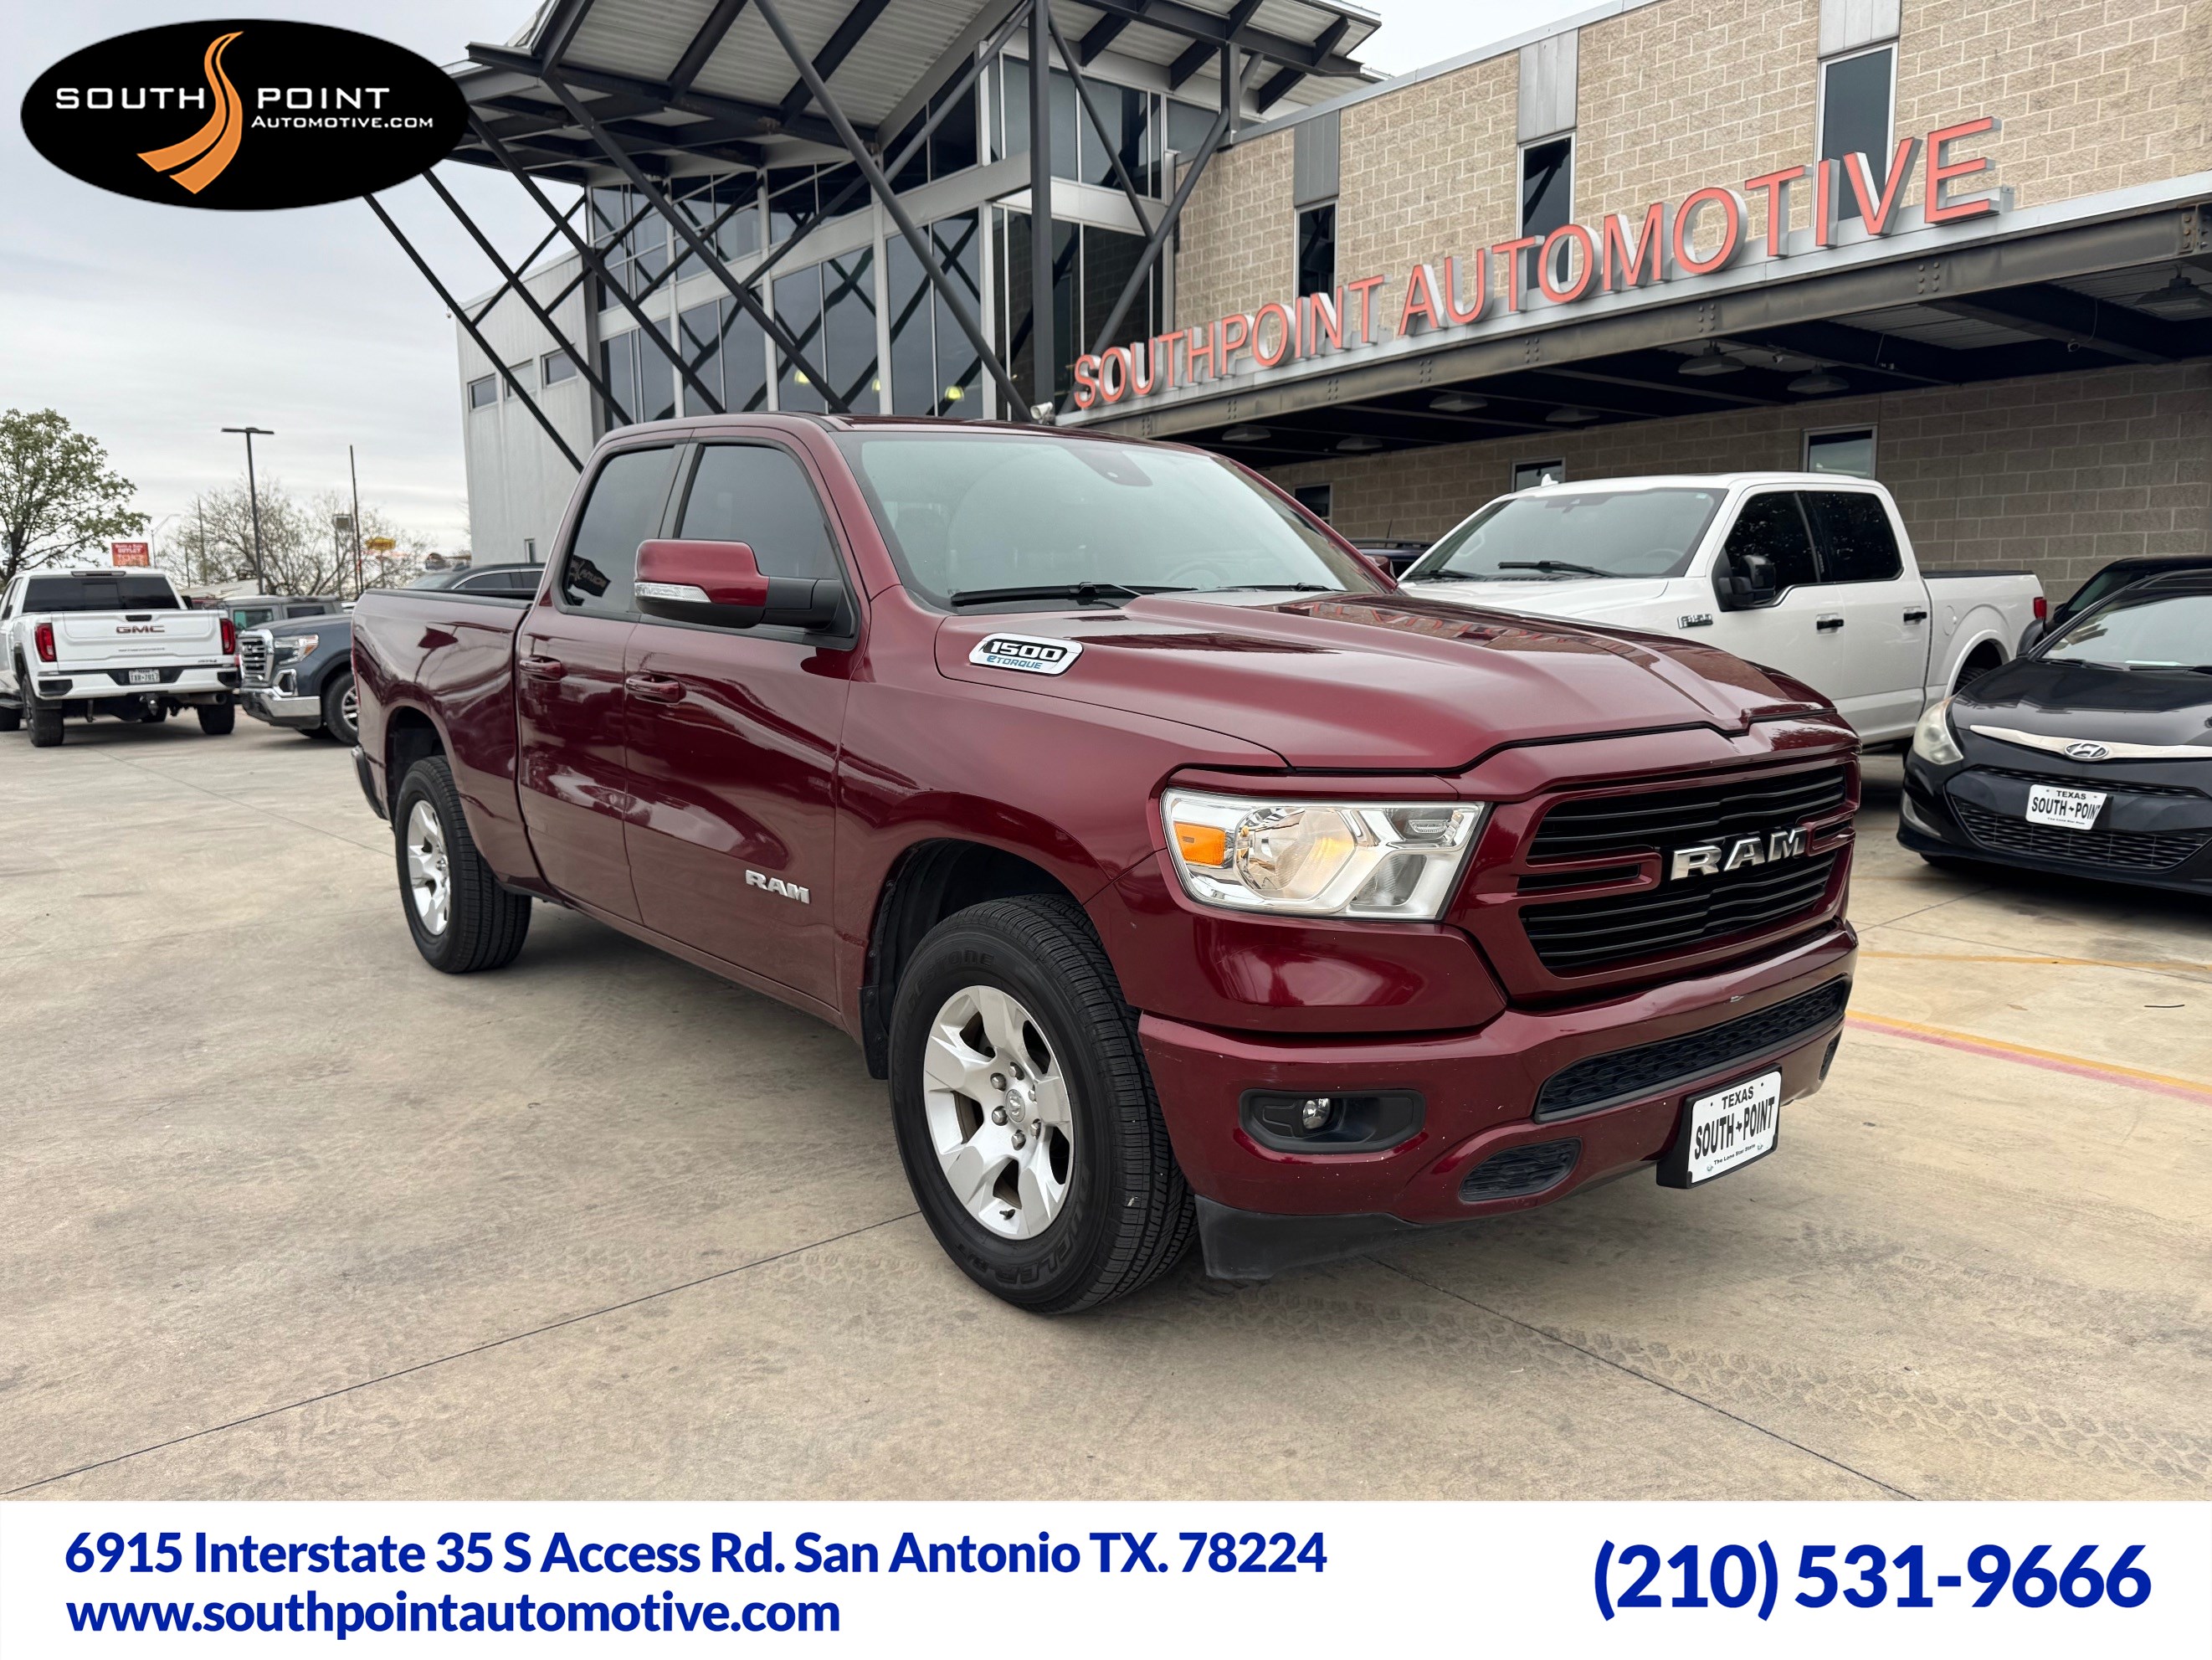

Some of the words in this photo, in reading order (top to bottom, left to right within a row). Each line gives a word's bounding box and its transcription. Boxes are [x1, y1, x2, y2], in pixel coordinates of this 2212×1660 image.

[1074, 274, 1388, 409] SOUTHPOINT
[1399, 116, 1999, 336] AUTOMOTIVE
[115, 624, 165, 635] GMC
[990, 640, 1064, 661] 1500
[2031, 796, 2067, 816] SOUTH
[2056, 789, 2086, 800] TEXAS
[1670, 826, 1808, 881] RAM
[745, 869, 810, 905] RAM
[1722, 1086, 1754, 1110] TEXAS
[1694, 1113, 1735, 1160] SOUTH
[1742, 1096, 1775, 1141] POINT
[1713, 1157, 1723, 1165] The
[1724, 1153, 1735, 1162] Lone
[1745, 1143, 1756, 1152] State
